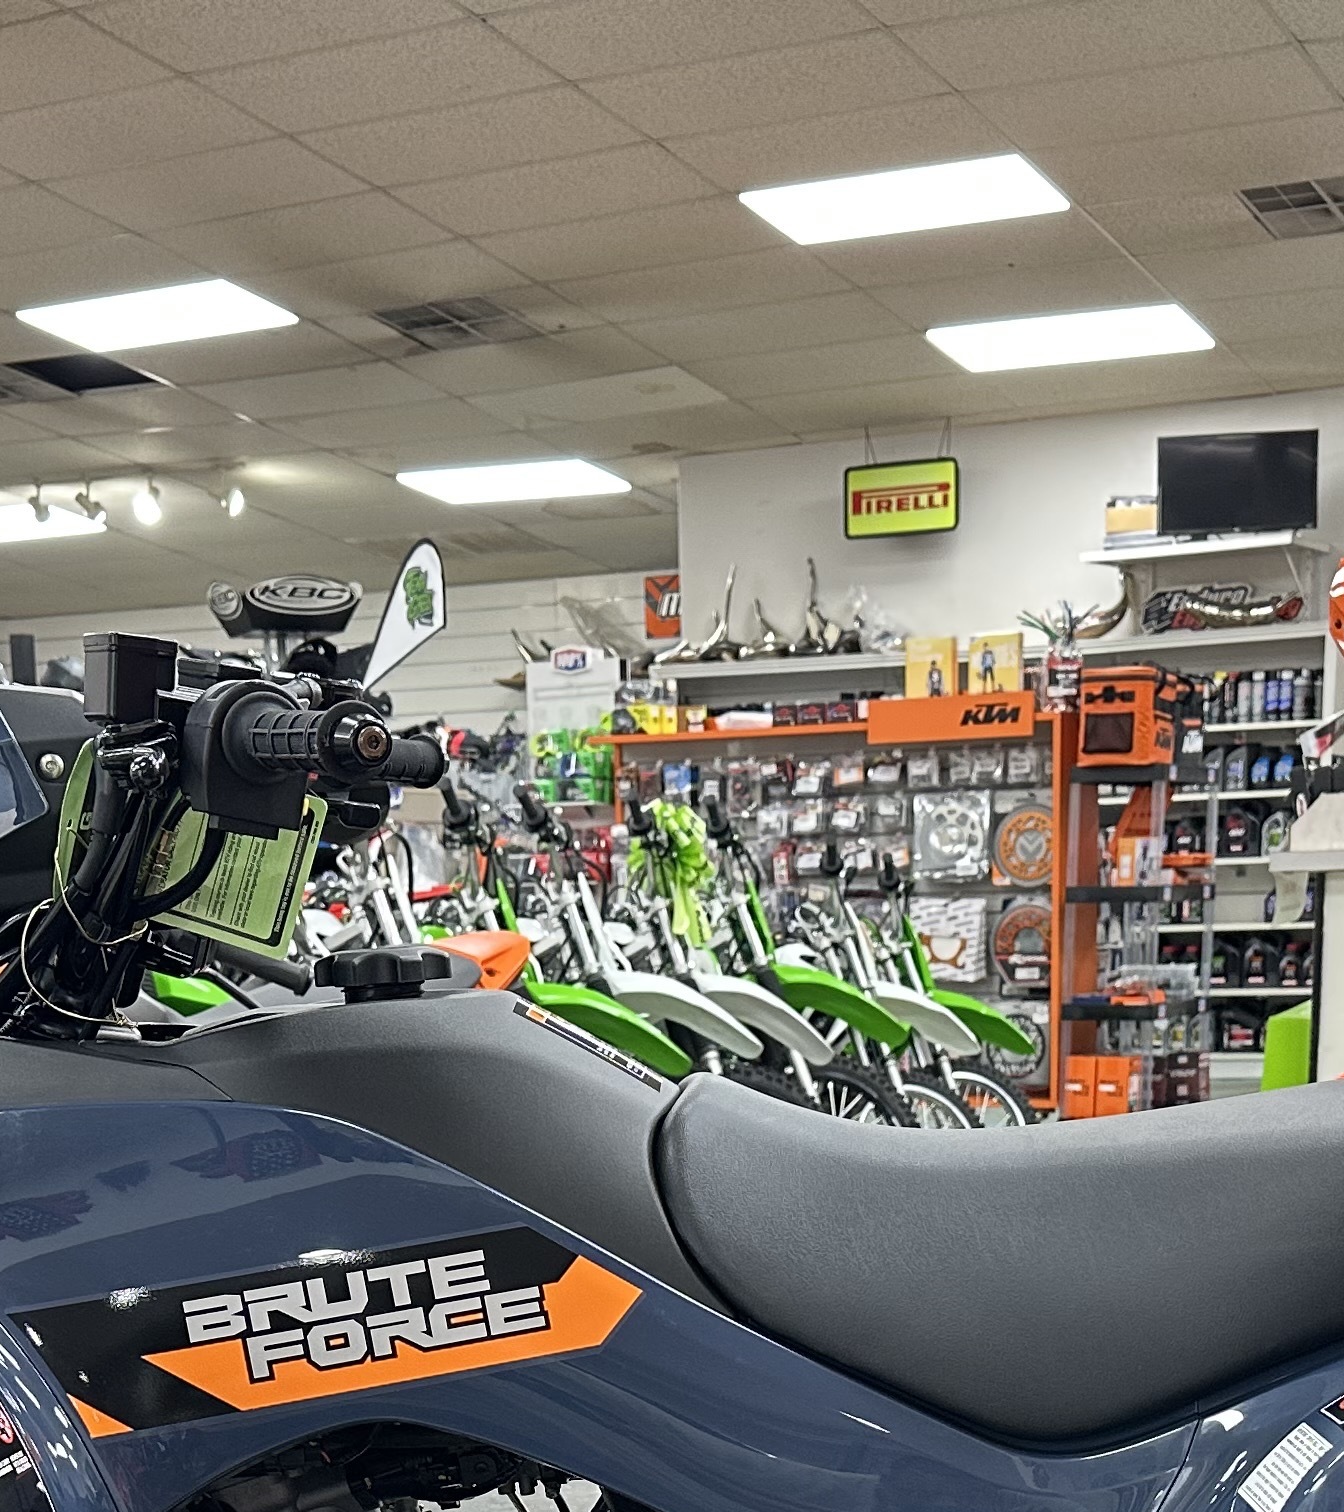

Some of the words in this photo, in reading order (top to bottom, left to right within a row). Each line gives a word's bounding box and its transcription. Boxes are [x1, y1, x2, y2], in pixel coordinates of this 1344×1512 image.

[852, 482, 951, 516] PIRELLI
[259, 584, 348, 600] KBC
[960, 702, 1021, 727] KTM
[184, 1249, 490, 1345] BRUTE
[249, 1285, 546, 1379] FORCE
